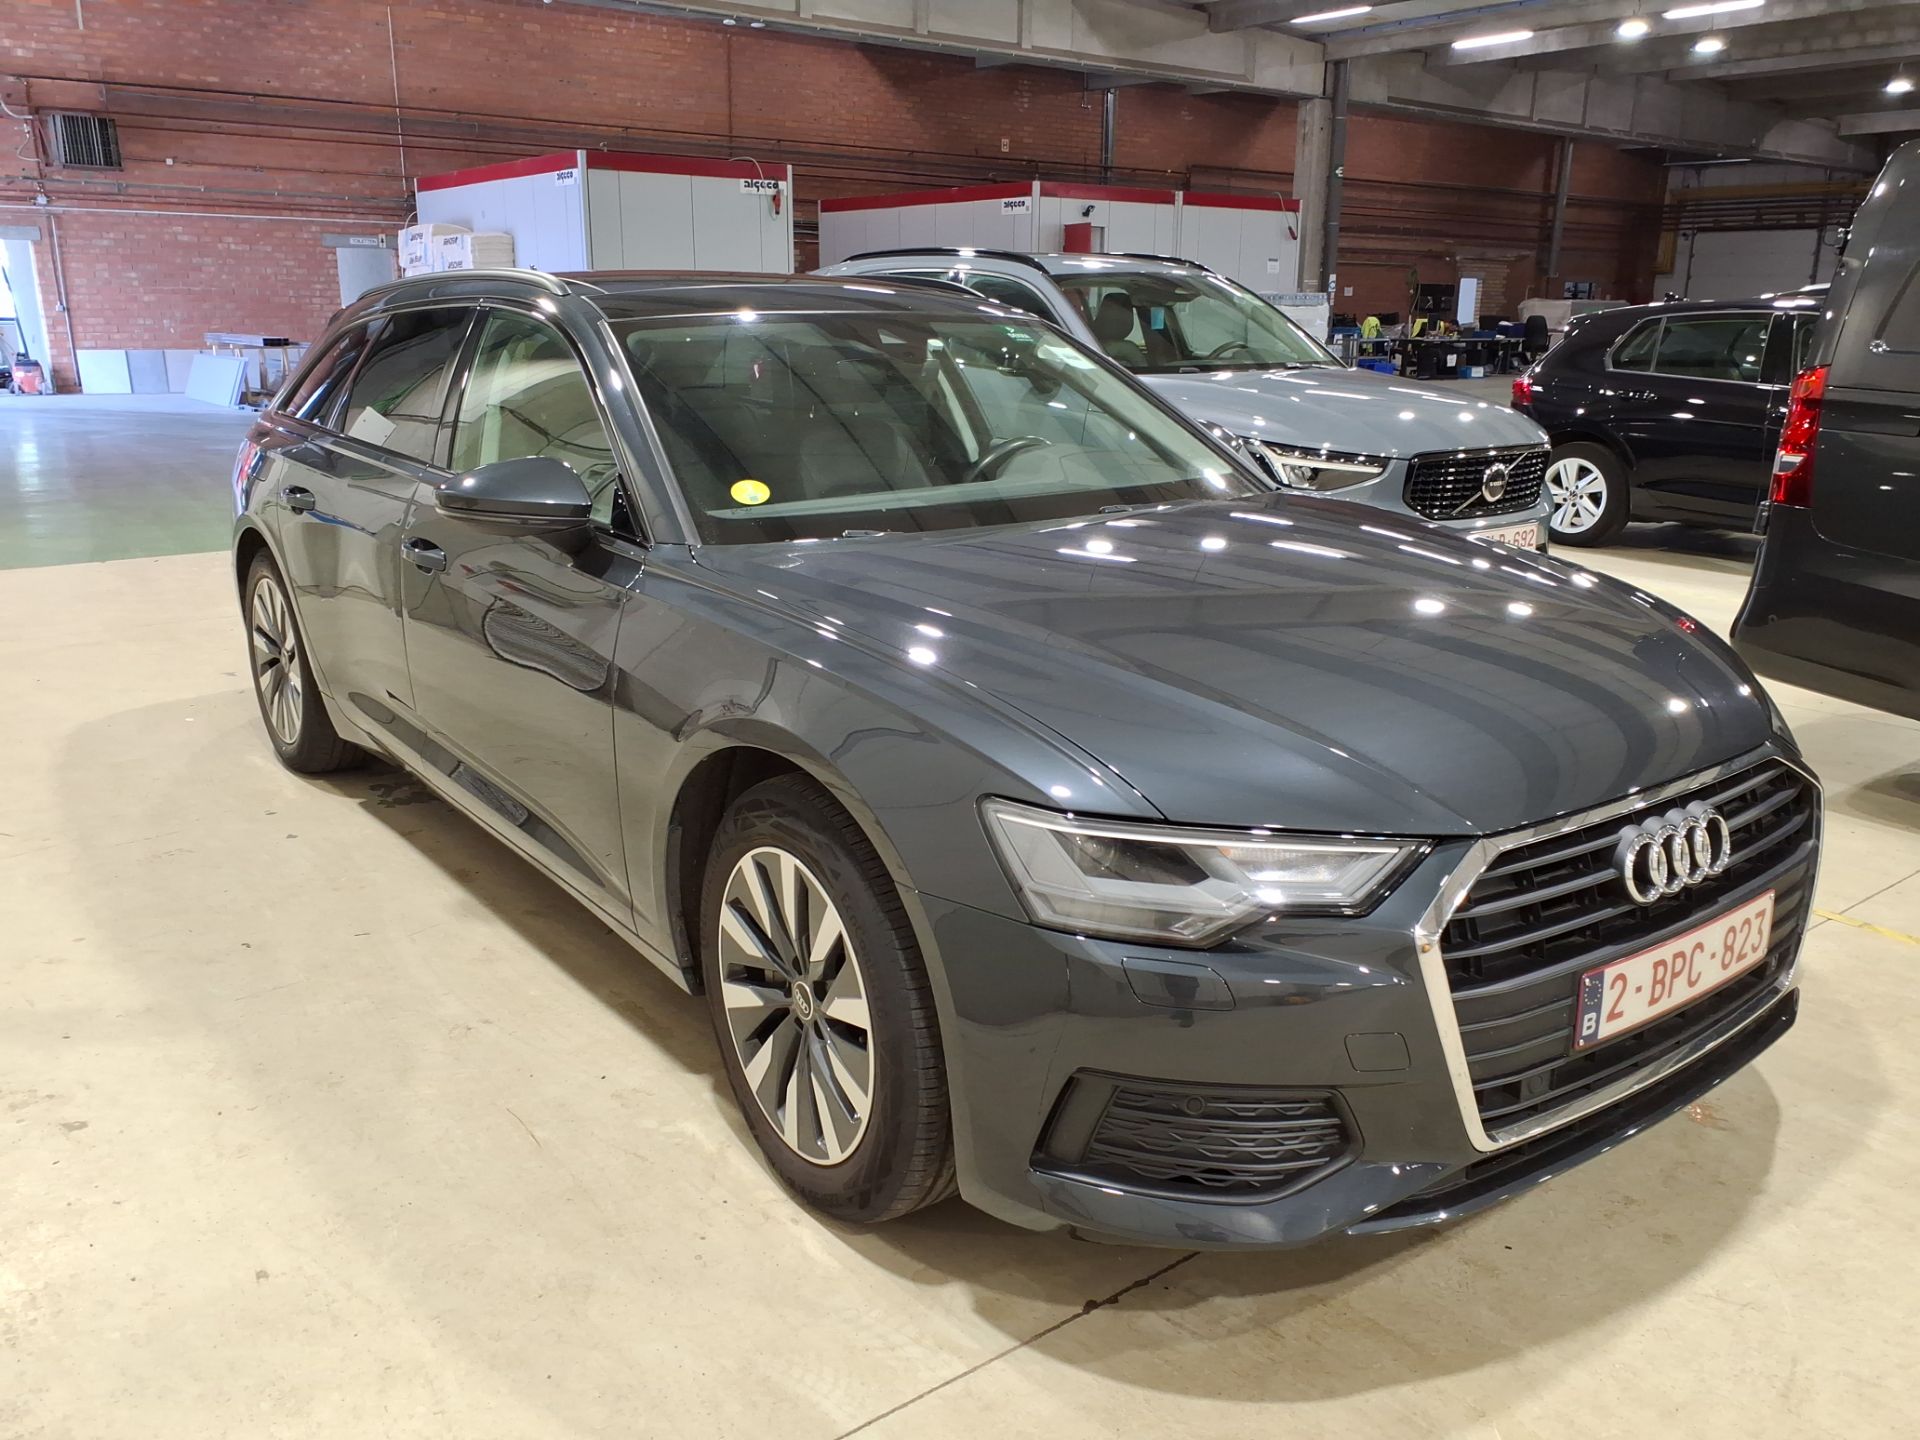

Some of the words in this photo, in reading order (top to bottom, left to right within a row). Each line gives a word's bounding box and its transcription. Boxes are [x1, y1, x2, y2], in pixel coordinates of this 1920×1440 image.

[743, 179, 779, 192] algeco
[1606, 908, 1766, 1023] 2-BPC-823
[1582, 1012, 1597, 1036] B
